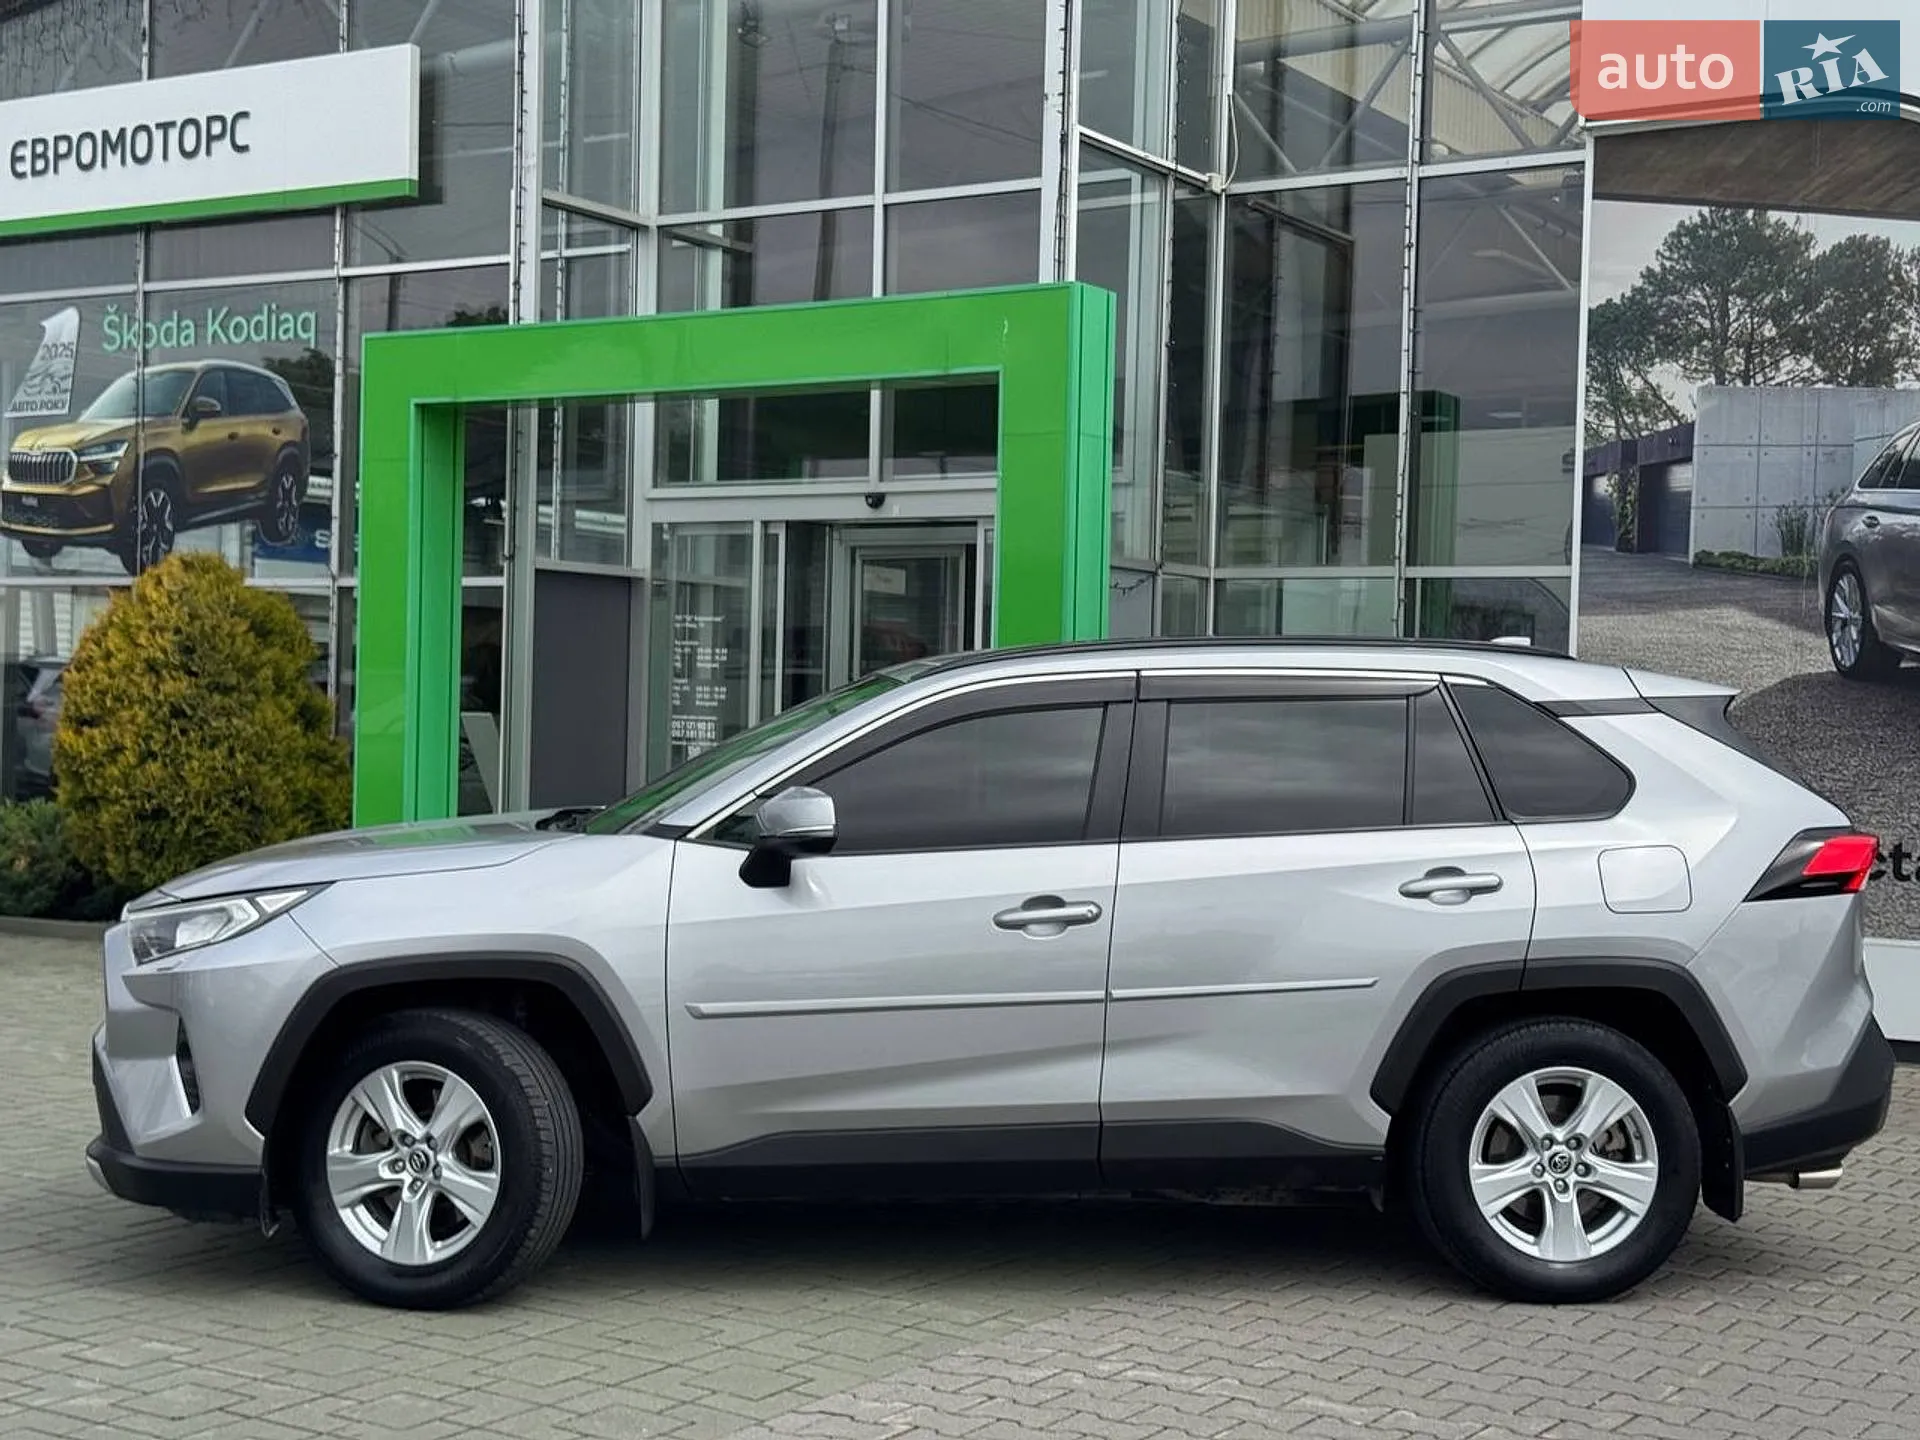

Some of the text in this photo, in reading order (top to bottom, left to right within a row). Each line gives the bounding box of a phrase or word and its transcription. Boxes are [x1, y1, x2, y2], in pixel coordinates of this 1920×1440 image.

[10, 111, 251, 180] ЄВРОМОТОРС
[41, 341, 75, 360] 2025
[102, 303, 317, 351] Škoda Kodiaq
